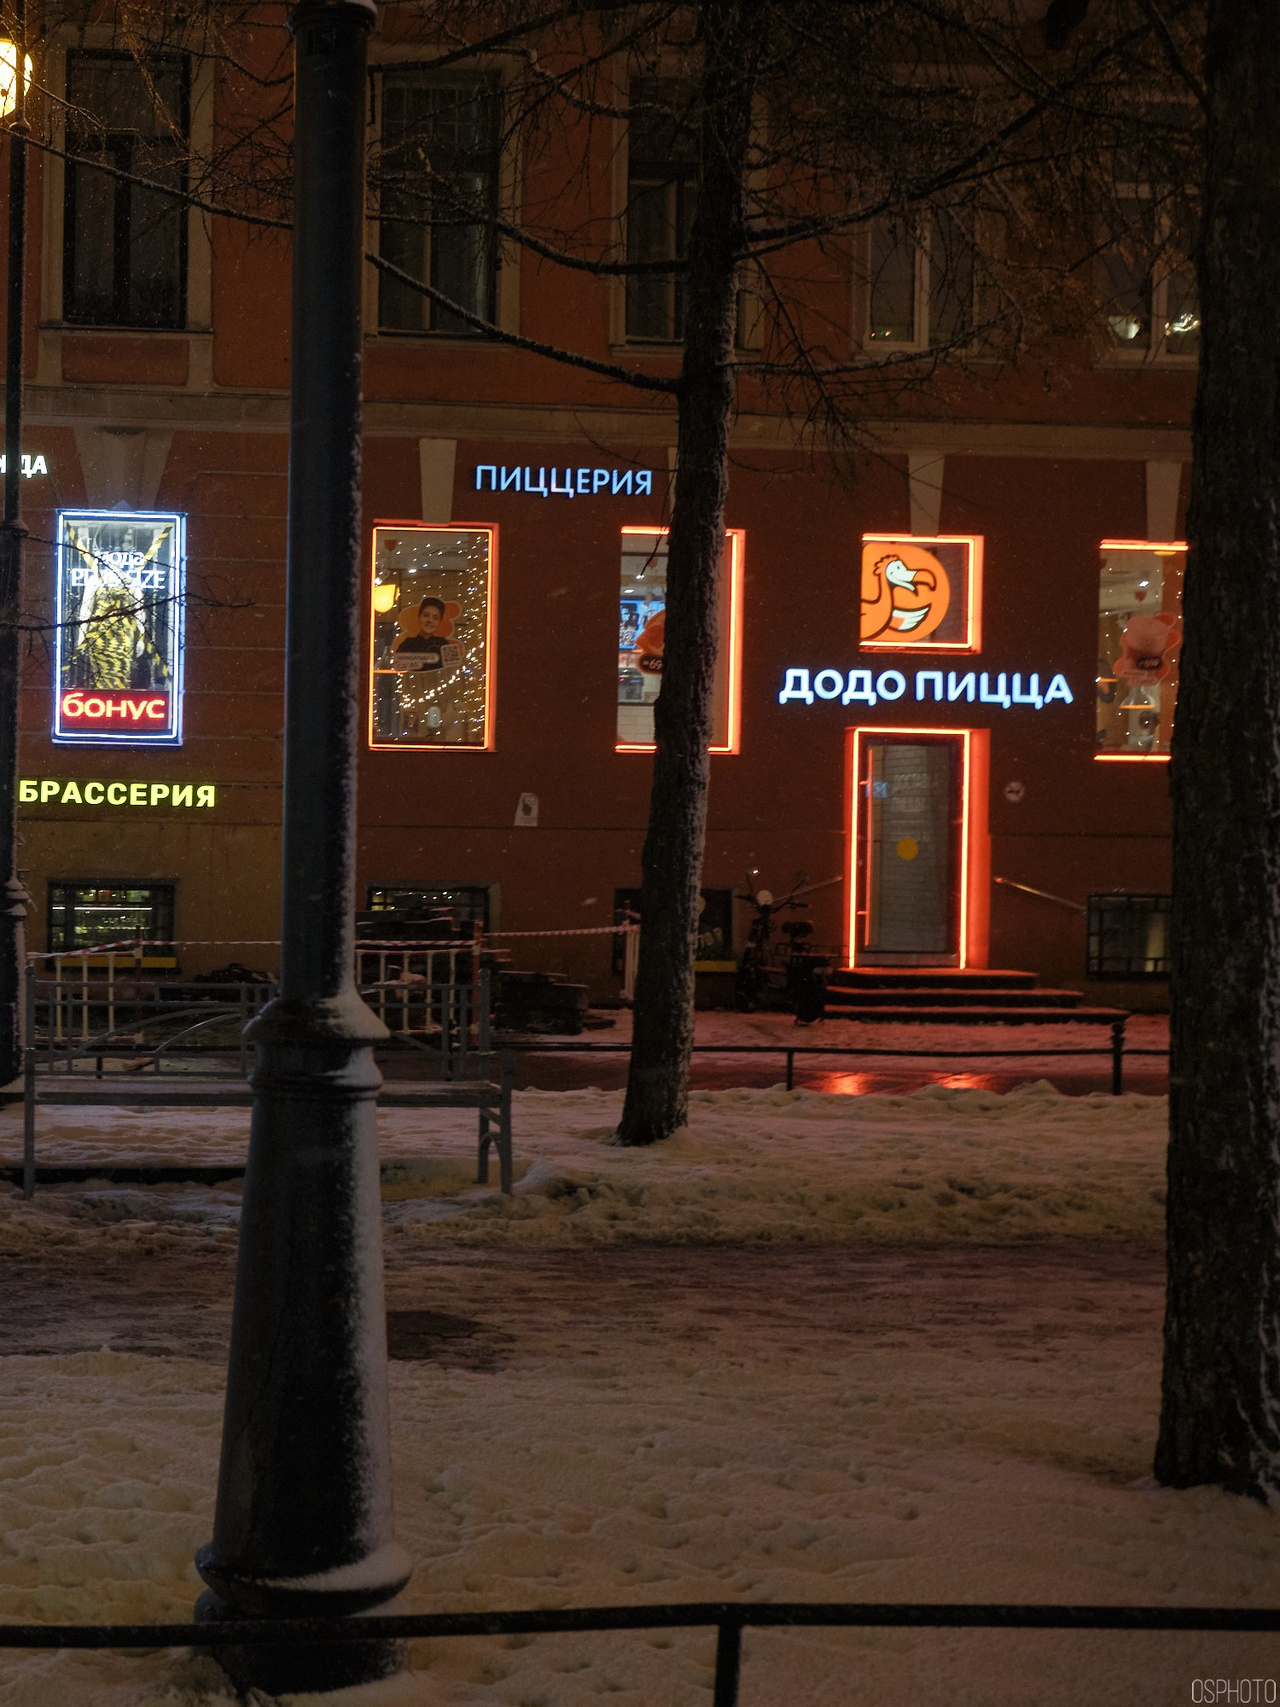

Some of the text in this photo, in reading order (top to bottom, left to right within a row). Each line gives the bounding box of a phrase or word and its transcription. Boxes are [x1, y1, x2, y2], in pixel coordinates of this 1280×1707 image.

[476, 465, 652, 498] ПИЦЦЕРИЯ
[779, 668, 1074, 710] ДОДО ПИЦЦА
[62, 692, 165, 720] бонус
[19, 780, 215, 807] БРАССЕРИЯ
